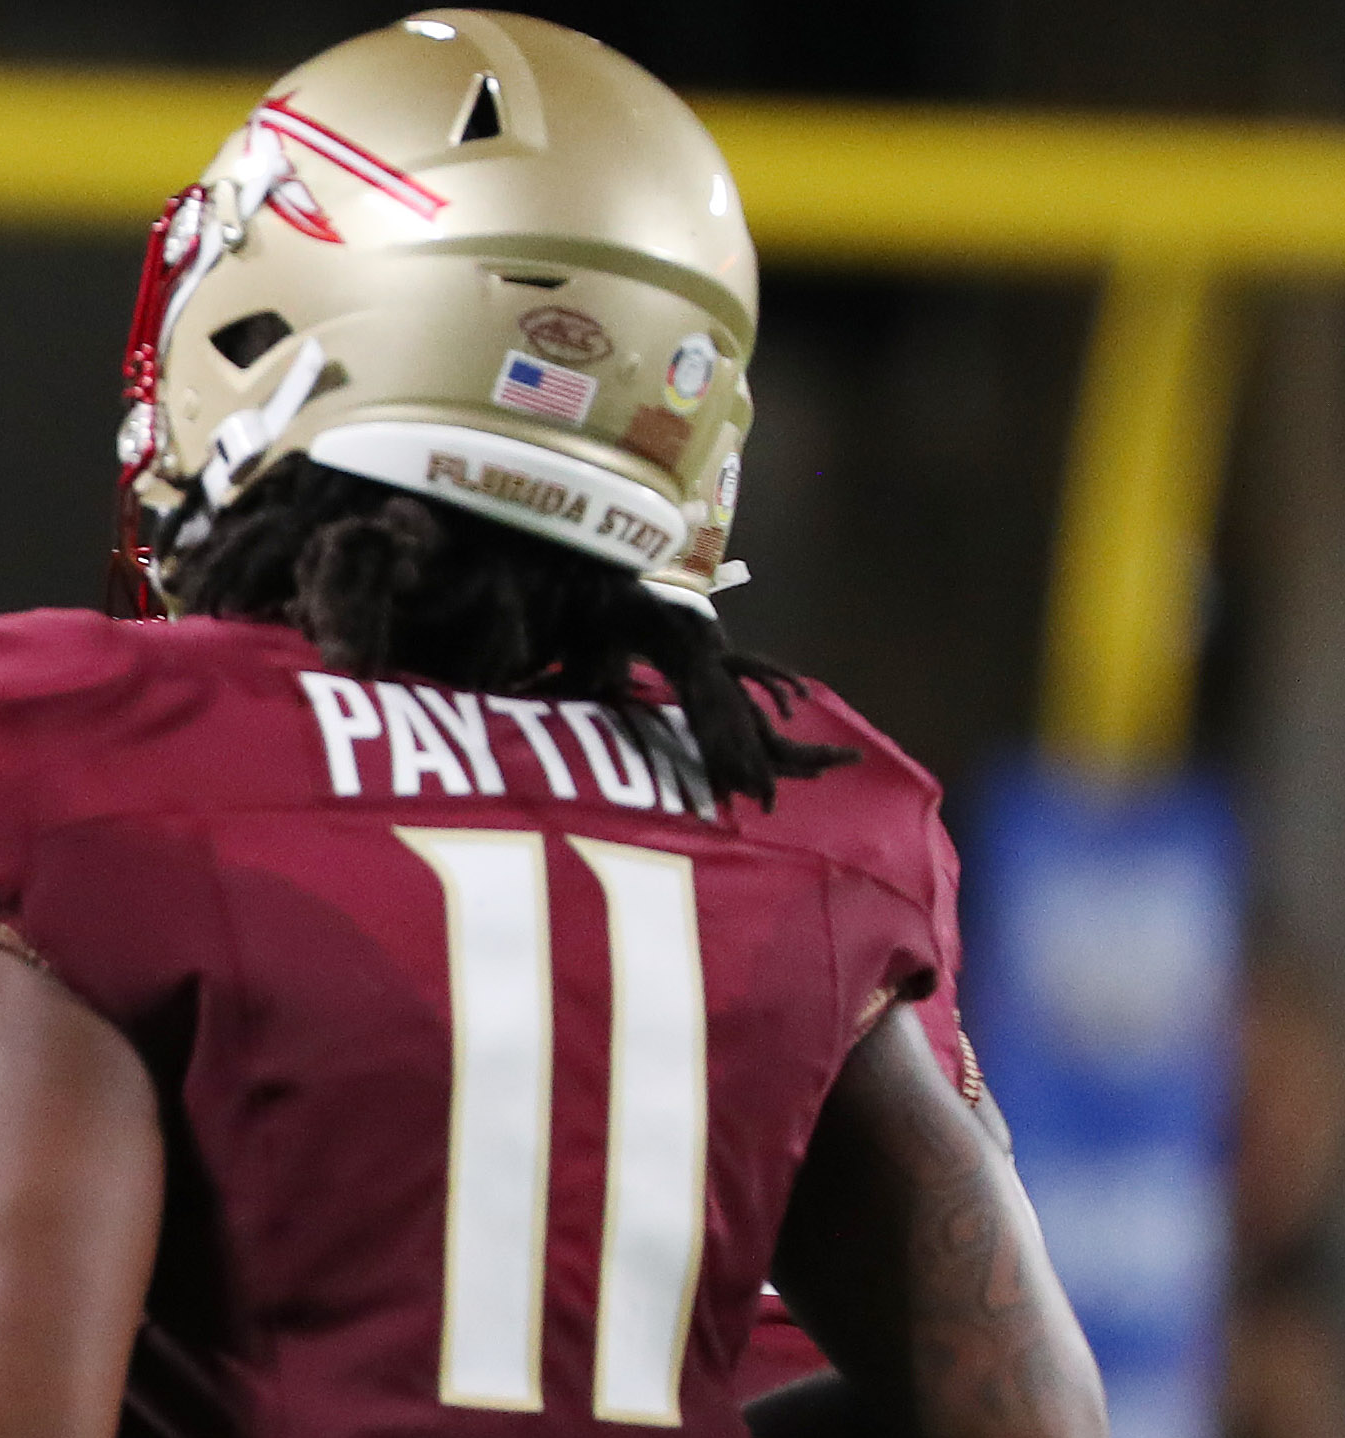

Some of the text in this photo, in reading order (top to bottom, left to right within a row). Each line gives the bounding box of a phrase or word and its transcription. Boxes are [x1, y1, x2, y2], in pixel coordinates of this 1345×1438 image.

[425, 450, 591, 525] FLORIDA
[298, 668, 717, 824] PAYTON
[390, 823, 709, 1429] 11
